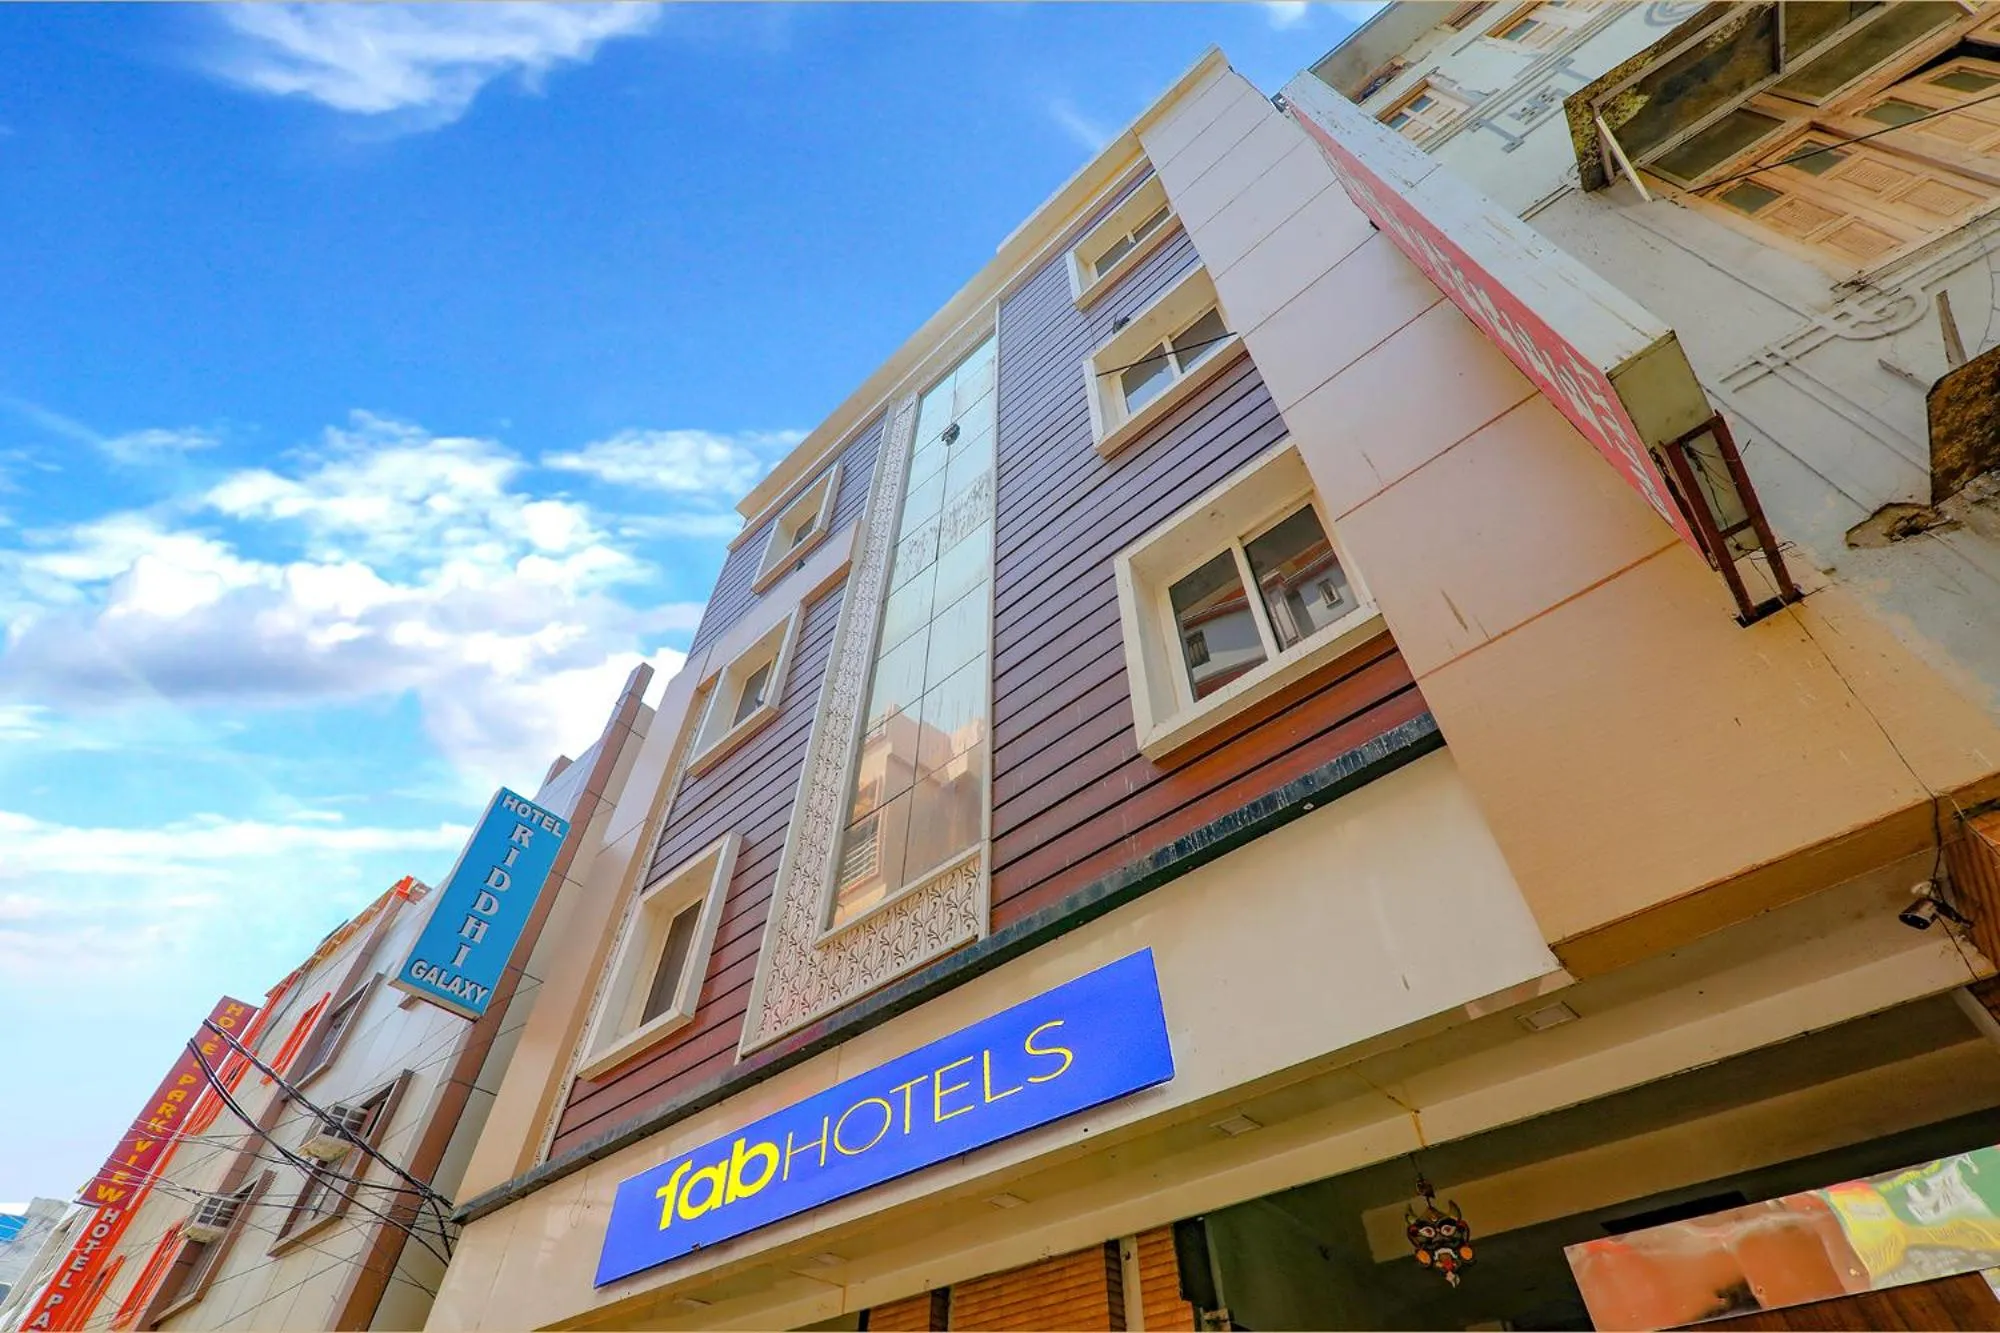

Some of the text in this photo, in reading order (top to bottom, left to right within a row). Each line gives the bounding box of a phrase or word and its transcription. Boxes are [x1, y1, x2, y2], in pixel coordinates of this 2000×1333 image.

[502, 795, 563, 838] HOTEL
[450, 822, 534, 968] RIDDHI
[410, 958, 489, 1005] GALAXY
[97, 1002, 246, 1202] HOE PARK VIEW
[24, 1207, 120, 1331] HOTEL PA
